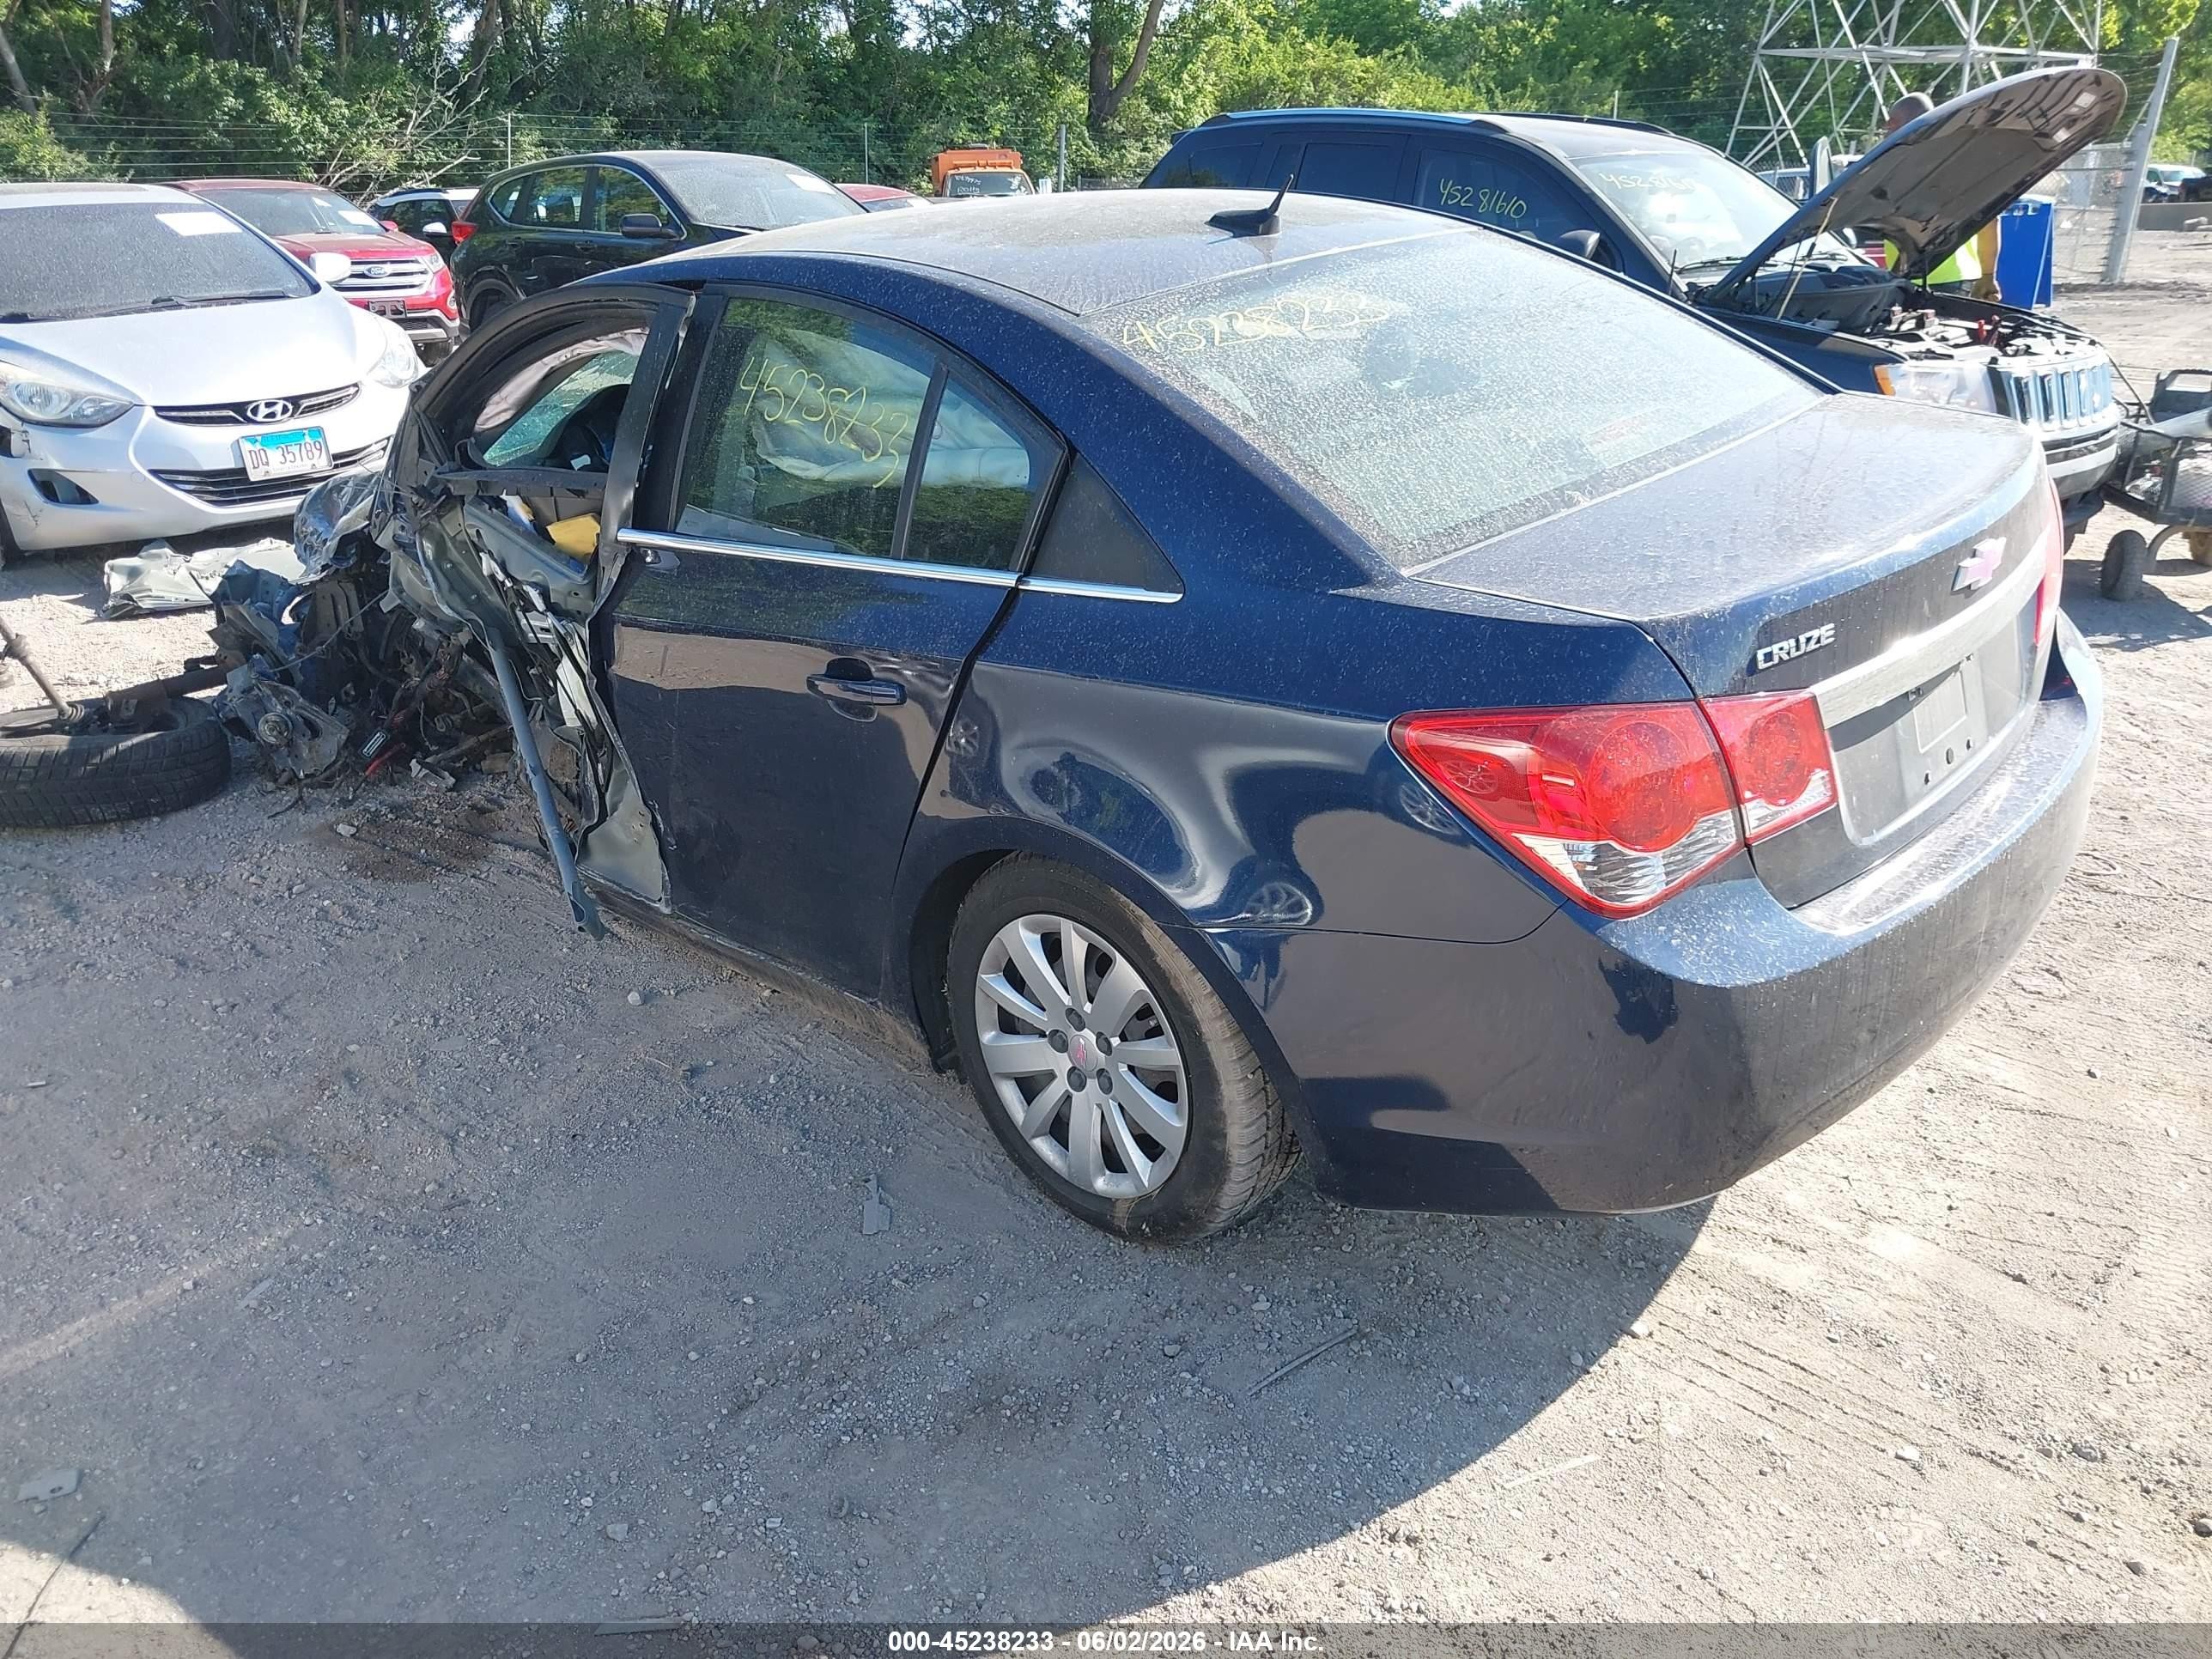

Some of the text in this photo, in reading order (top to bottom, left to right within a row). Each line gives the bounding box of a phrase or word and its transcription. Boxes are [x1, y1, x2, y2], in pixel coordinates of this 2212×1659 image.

[1440, 178, 1527, 218] 45281610
[740, 357, 909, 489] 45238233
[248, 447, 270, 470] DQ
[276, 440, 323, 465] 35789
[1757, 623, 1836, 670] CRUZE
